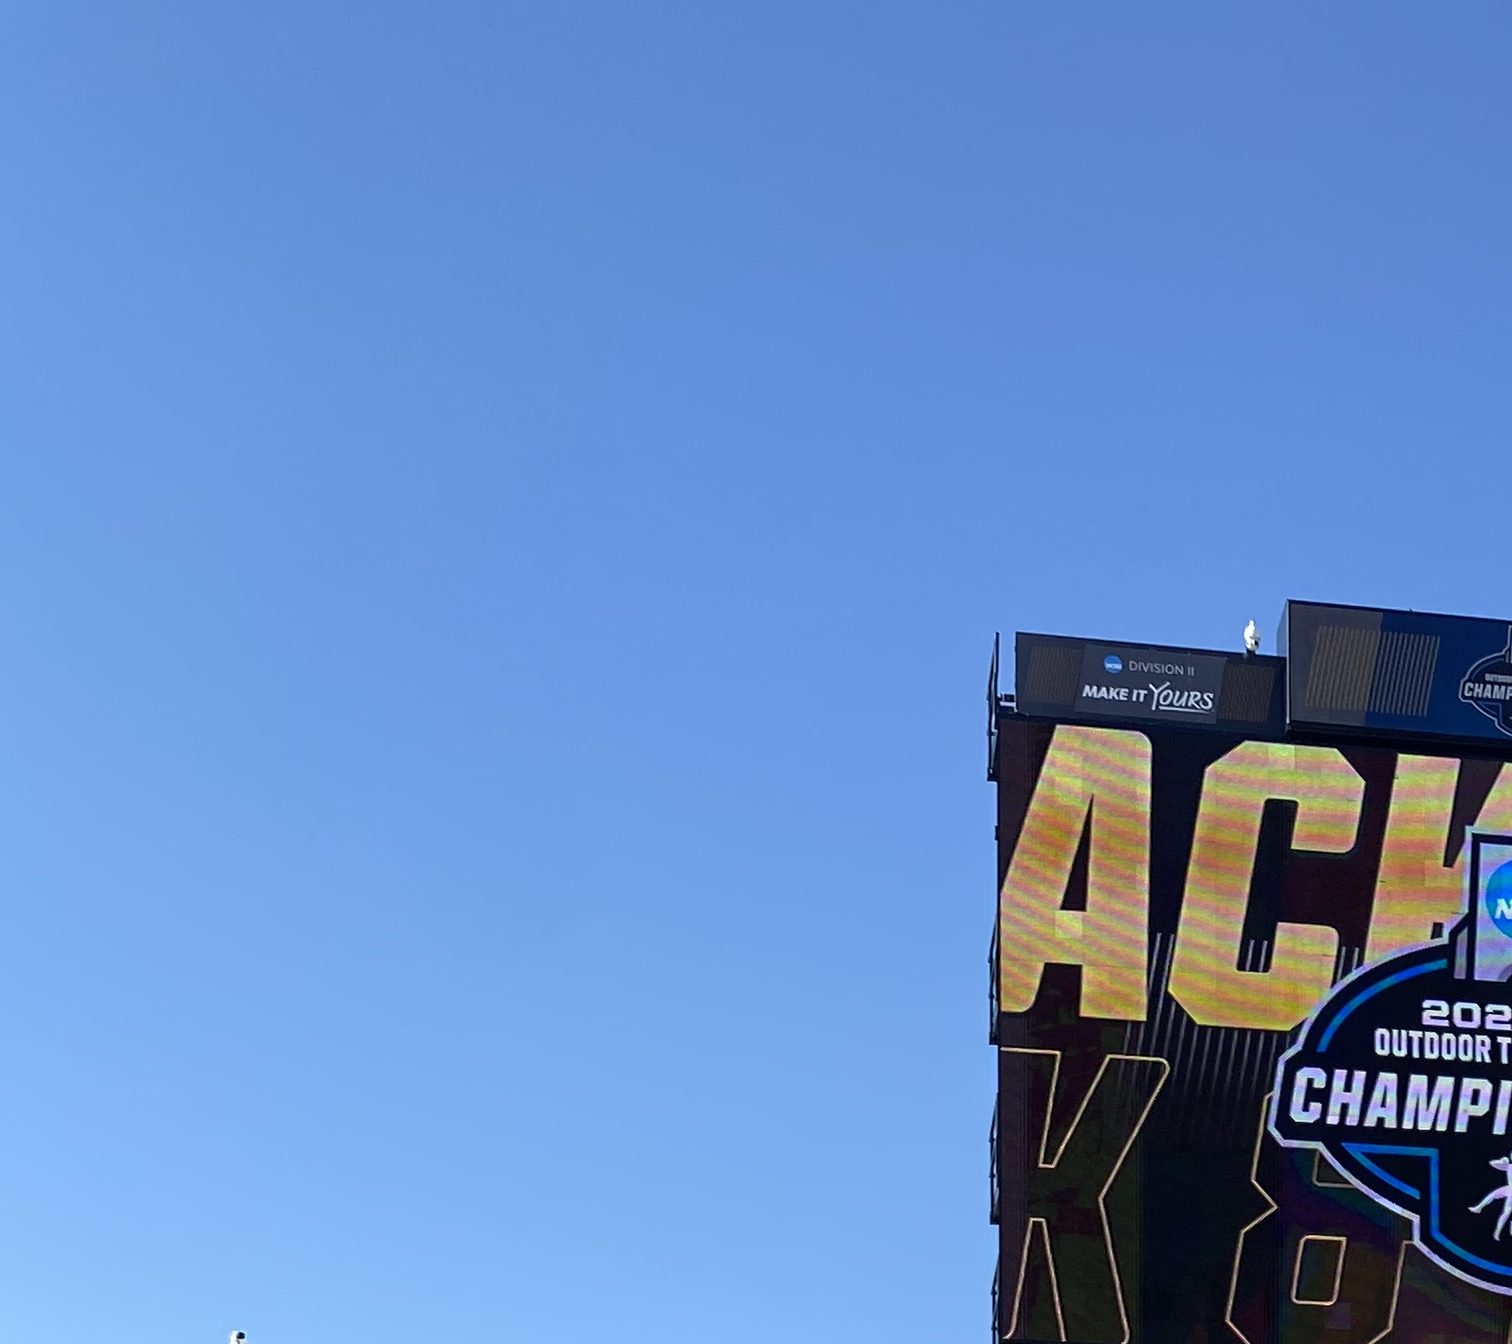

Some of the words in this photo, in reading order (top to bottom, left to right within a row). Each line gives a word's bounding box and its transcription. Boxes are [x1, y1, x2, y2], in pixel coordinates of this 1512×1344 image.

[1128, 660, 1184, 675] DIVISION
[1188, 667, 1195, 677] II
[1082, 685, 1129, 700] MAKE
[1132, 689, 1148, 702] IT
[1374, 1027, 1492, 1064] OUTDOOR
